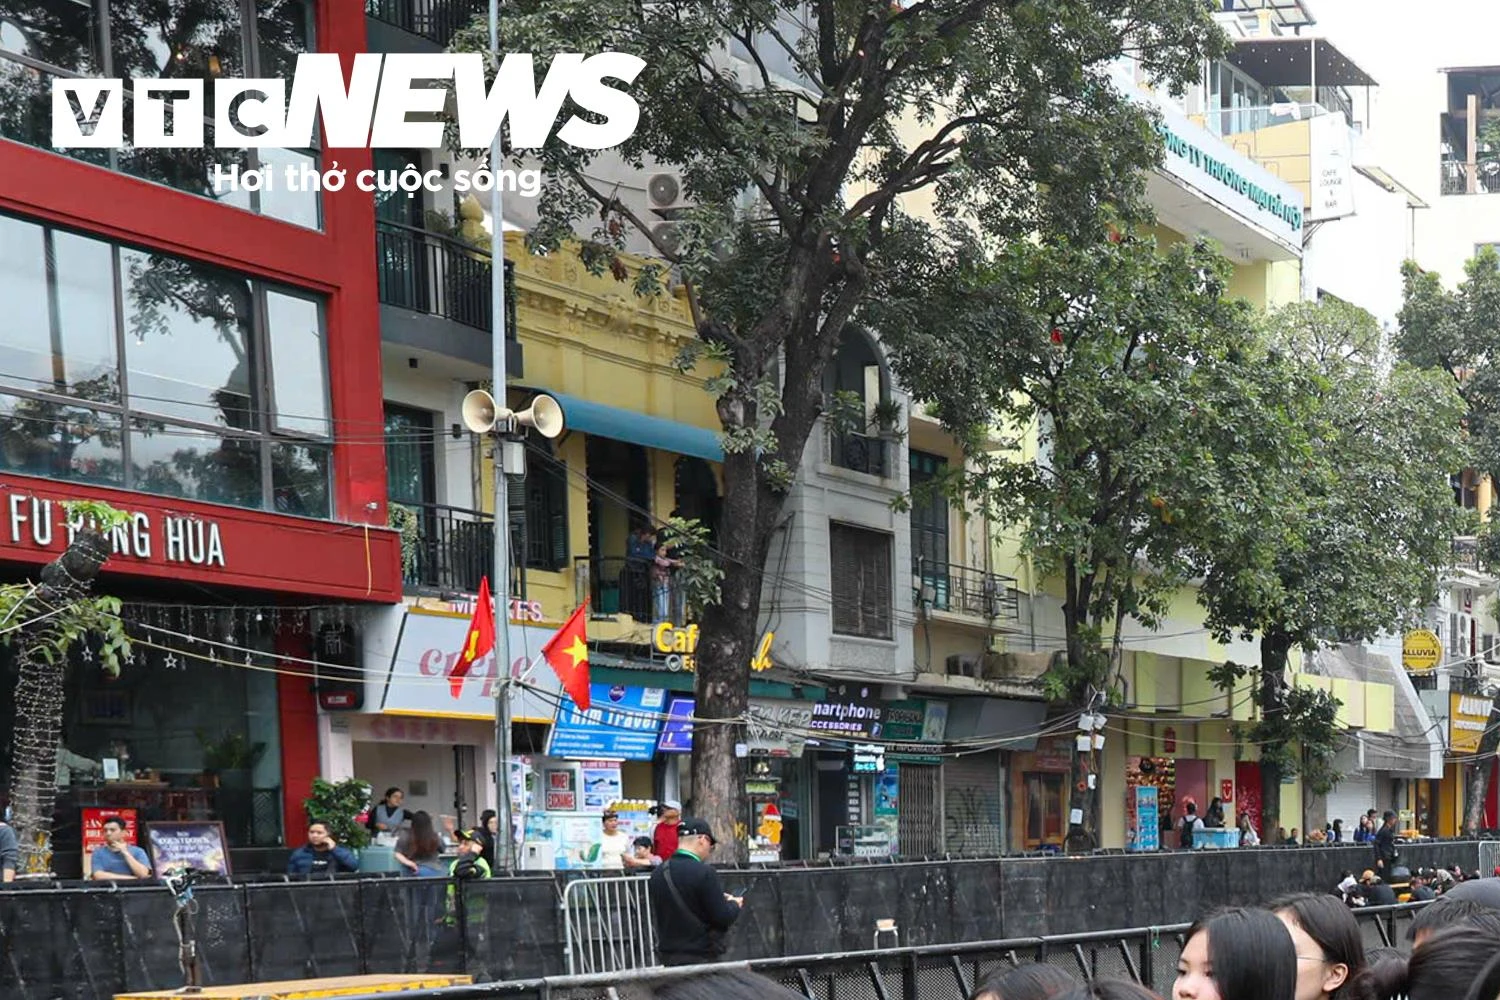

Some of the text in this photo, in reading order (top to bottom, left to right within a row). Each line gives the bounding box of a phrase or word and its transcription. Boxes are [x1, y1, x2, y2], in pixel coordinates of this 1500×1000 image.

[1188, 144, 1203, 168] TY
[9, 493, 52, 546] FU
[165, 514, 225, 567] HUA
[1402, 648, 1436, 656] ALLUVIA
